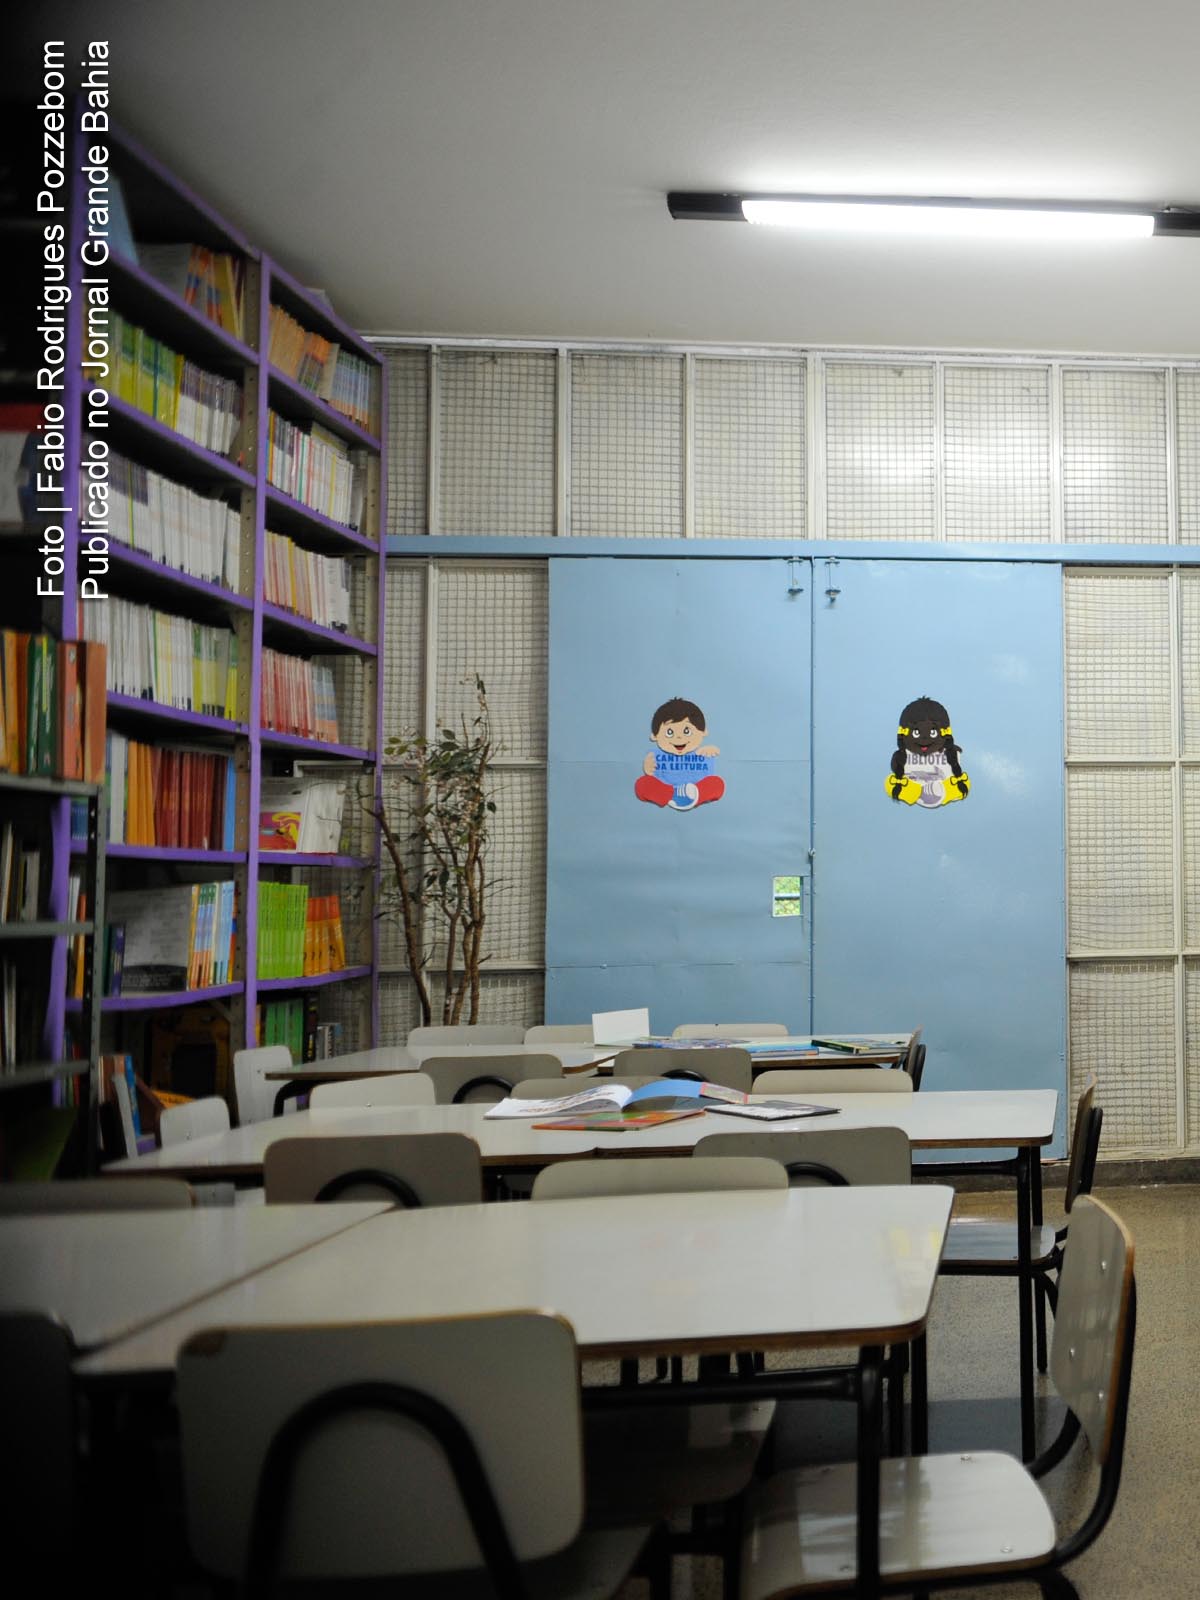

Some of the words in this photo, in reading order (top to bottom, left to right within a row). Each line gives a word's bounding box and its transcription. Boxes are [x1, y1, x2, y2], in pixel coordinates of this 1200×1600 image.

[655, 754, 705, 762] CANTINHO
[907, 753, 948, 765] IBLIOTE
[670, 763, 709, 771] LEITURA
